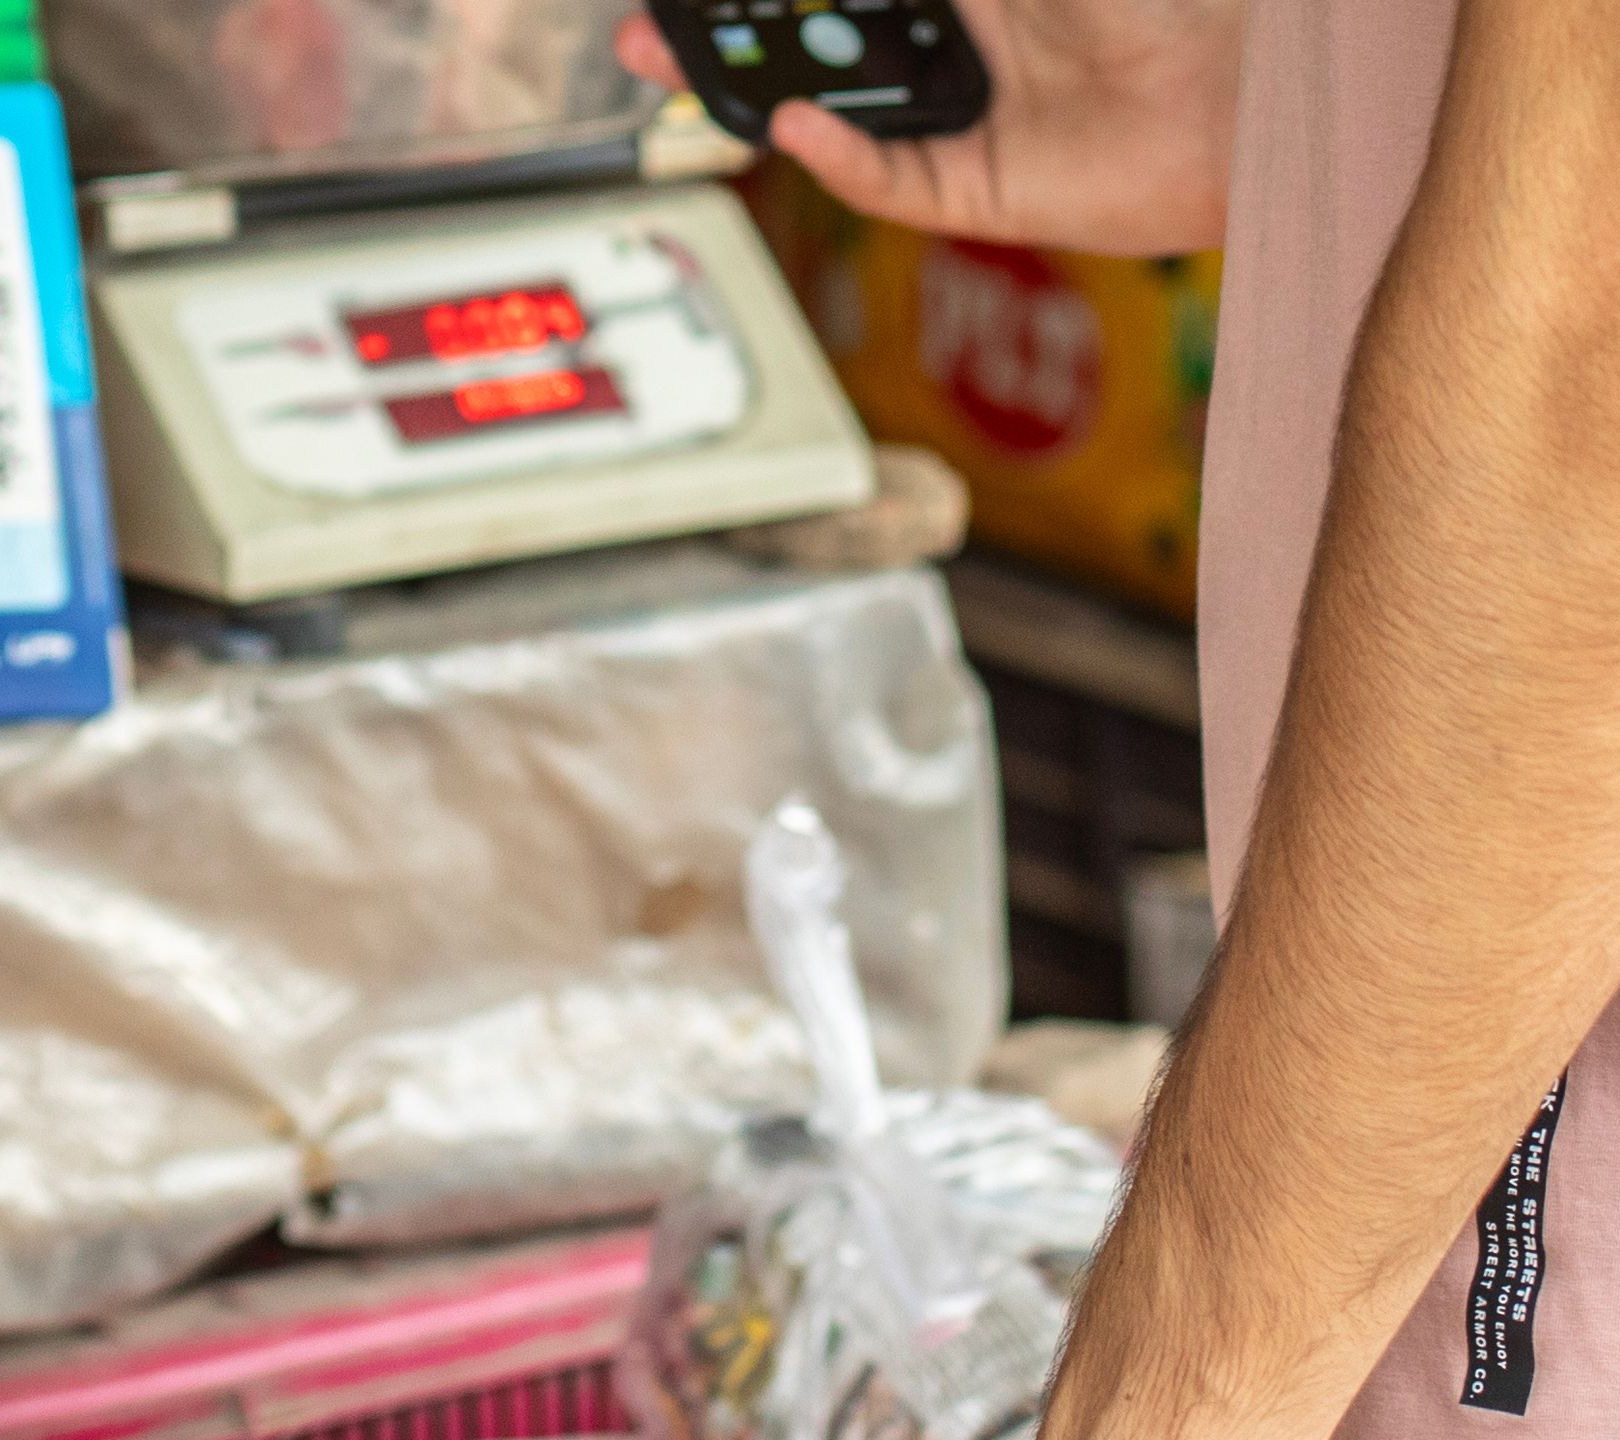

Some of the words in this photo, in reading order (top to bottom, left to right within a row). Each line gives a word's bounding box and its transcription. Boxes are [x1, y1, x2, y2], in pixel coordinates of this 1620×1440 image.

[1507, 1153, 1521, 1196] MOVE
[1524, 1128, 1547, 1182] THE
[1506, 1203, 1517, 1232] THE
[1480, 1221, 1499, 1290] STREET
[1505, 1237, 1519, 1279] MORE
[1512, 1198, 1538, 1322] STREETS
[1496, 1284, 1512, 1316] YOU
[1474, 1295, 1488, 1361] ARMOR
[1495, 1321, 1507, 1370] ENJOY
[1469, 1368, 1486, 1399] CO.
